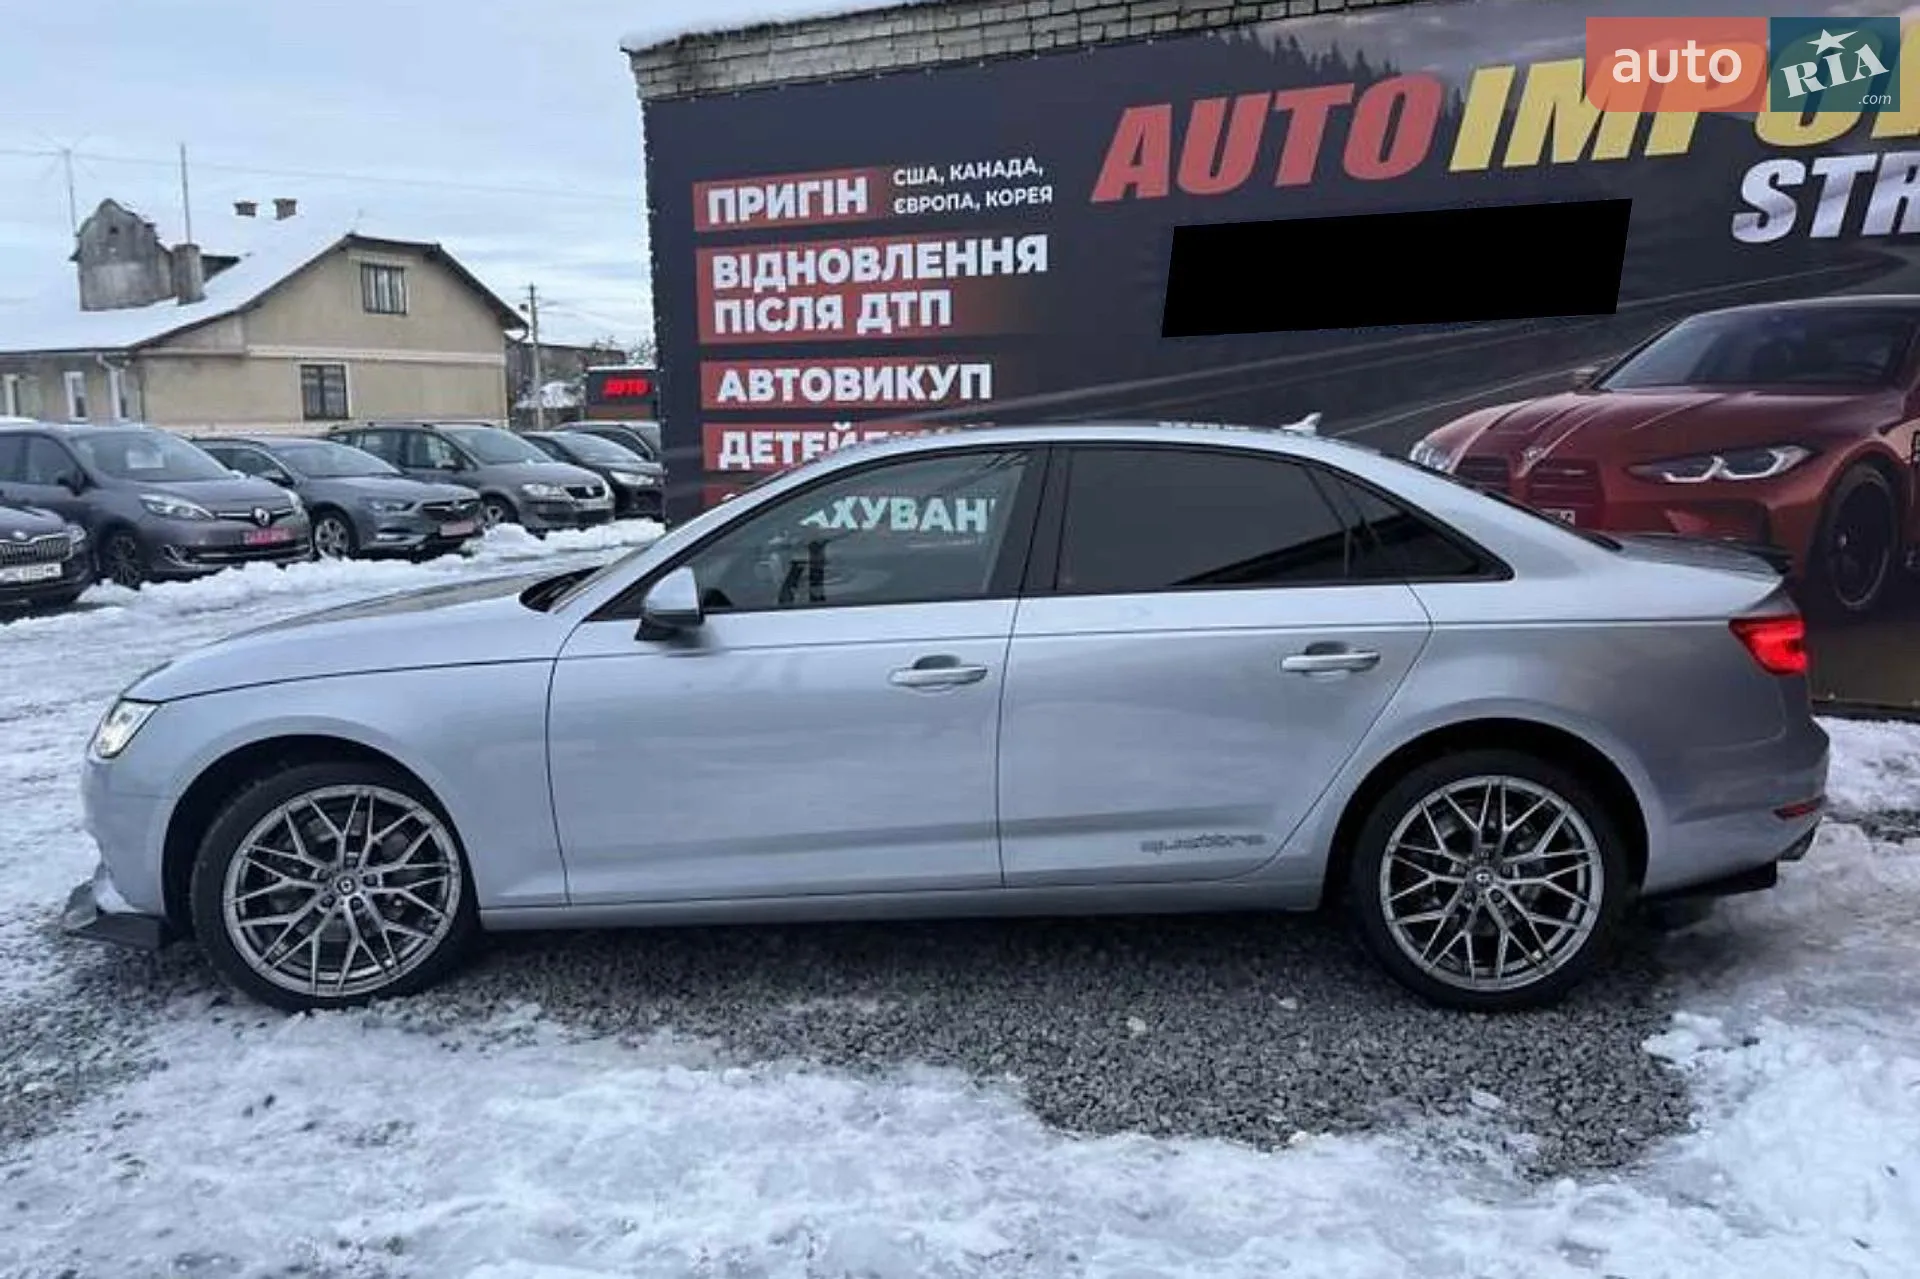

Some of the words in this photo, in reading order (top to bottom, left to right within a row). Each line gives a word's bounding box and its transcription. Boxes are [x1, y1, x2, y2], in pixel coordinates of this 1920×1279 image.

[1091, 71, 1443, 203] AUTO
[893, 166, 945, 187] США,
[950, 156, 1043, 181] КАНАДА,
[707, 176, 869, 225] ПРИГІН
[894, 192, 980, 214] ЄВРОПА,
[986, 184, 1053, 207] КОРЕЯ
[712, 234, 1049, 292] ВІДНОВЛЕННЯ
[713, 295, 844, 334] ПІСЛЯ
[856, 290, 952, 335] ДТП
[717, 363, 992, 402] АВТОВИКУП
[719, 422, 950, 470] ДЕТЕЙ
[800, 496, 996, 532] АХУВАН
